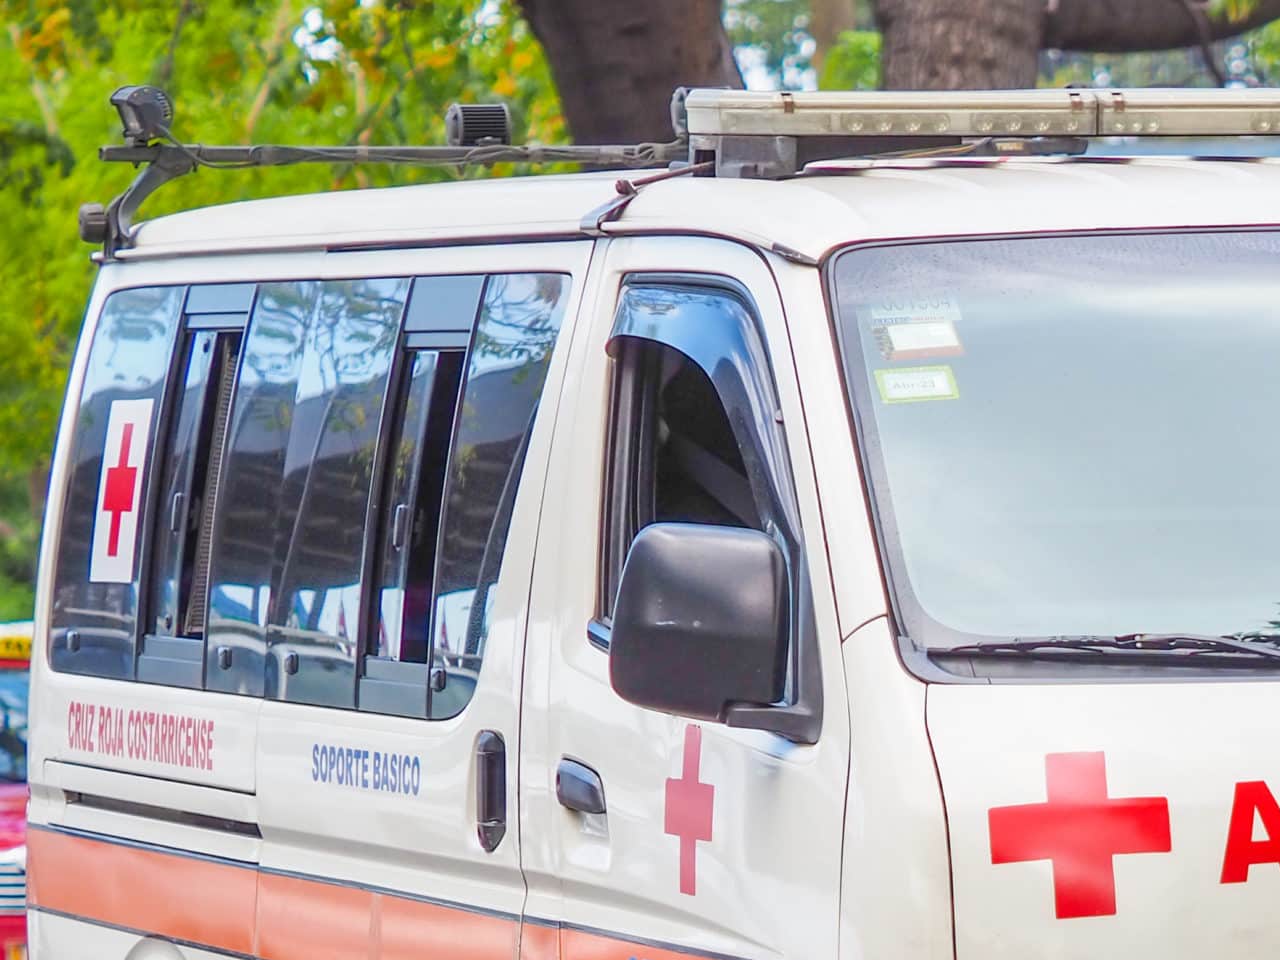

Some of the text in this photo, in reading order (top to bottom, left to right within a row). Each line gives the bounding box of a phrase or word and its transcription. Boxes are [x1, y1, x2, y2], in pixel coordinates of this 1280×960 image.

[67, 701, 214, 770] CRUZ ROJA COSTARRICENSE
[312, 743, 420, 796] SOPORTE BASICO
